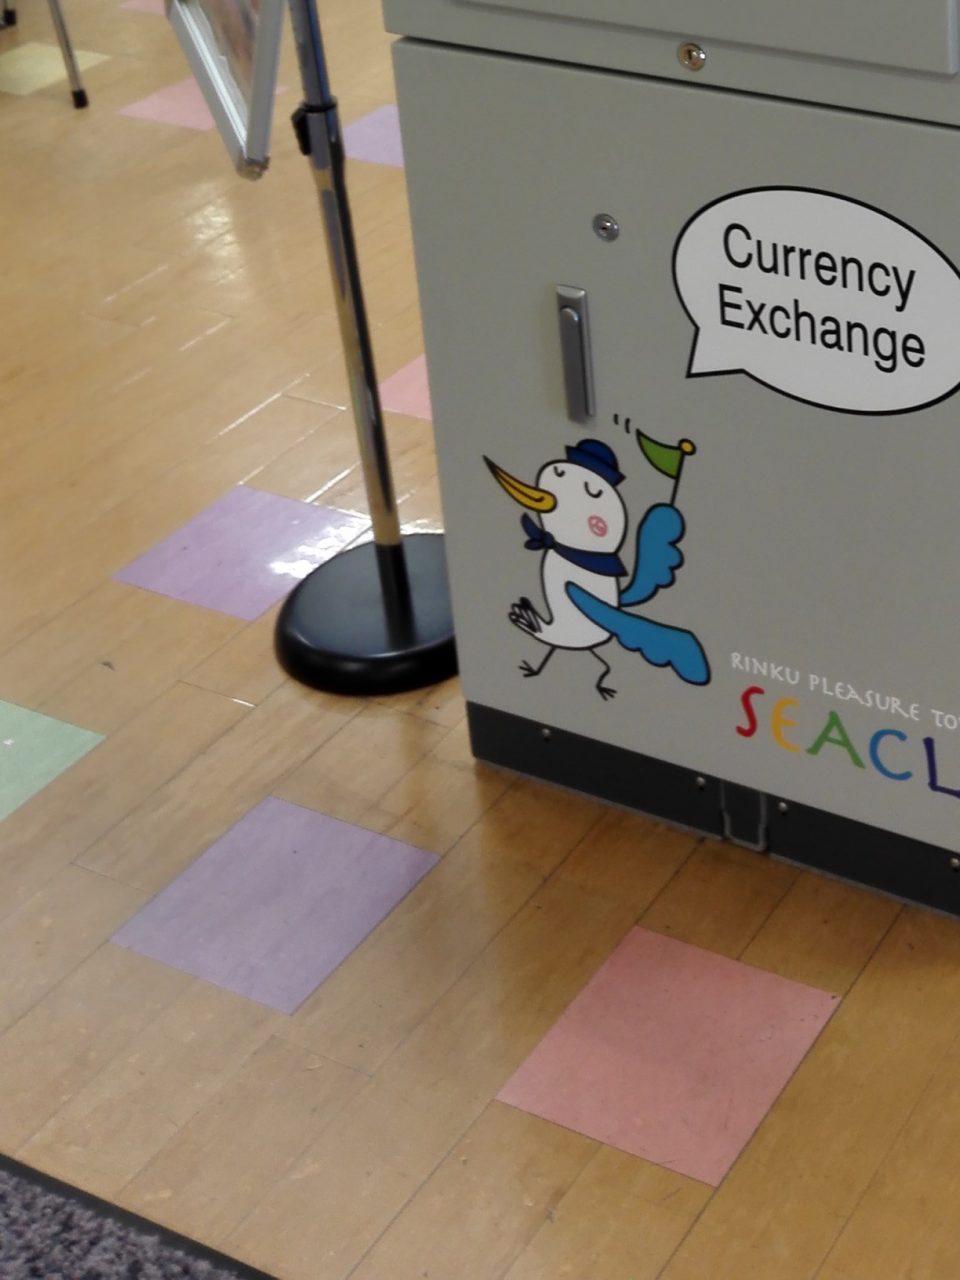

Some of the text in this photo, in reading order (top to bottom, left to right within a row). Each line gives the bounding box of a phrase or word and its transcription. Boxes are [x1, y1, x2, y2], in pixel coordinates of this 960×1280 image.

[722, 222, 917, 313] Currency
[718, 282, 927, 374] Exchange
[730, 651, 800, 686] RINKU
[808, 673, 921, 721] PLEASURE
